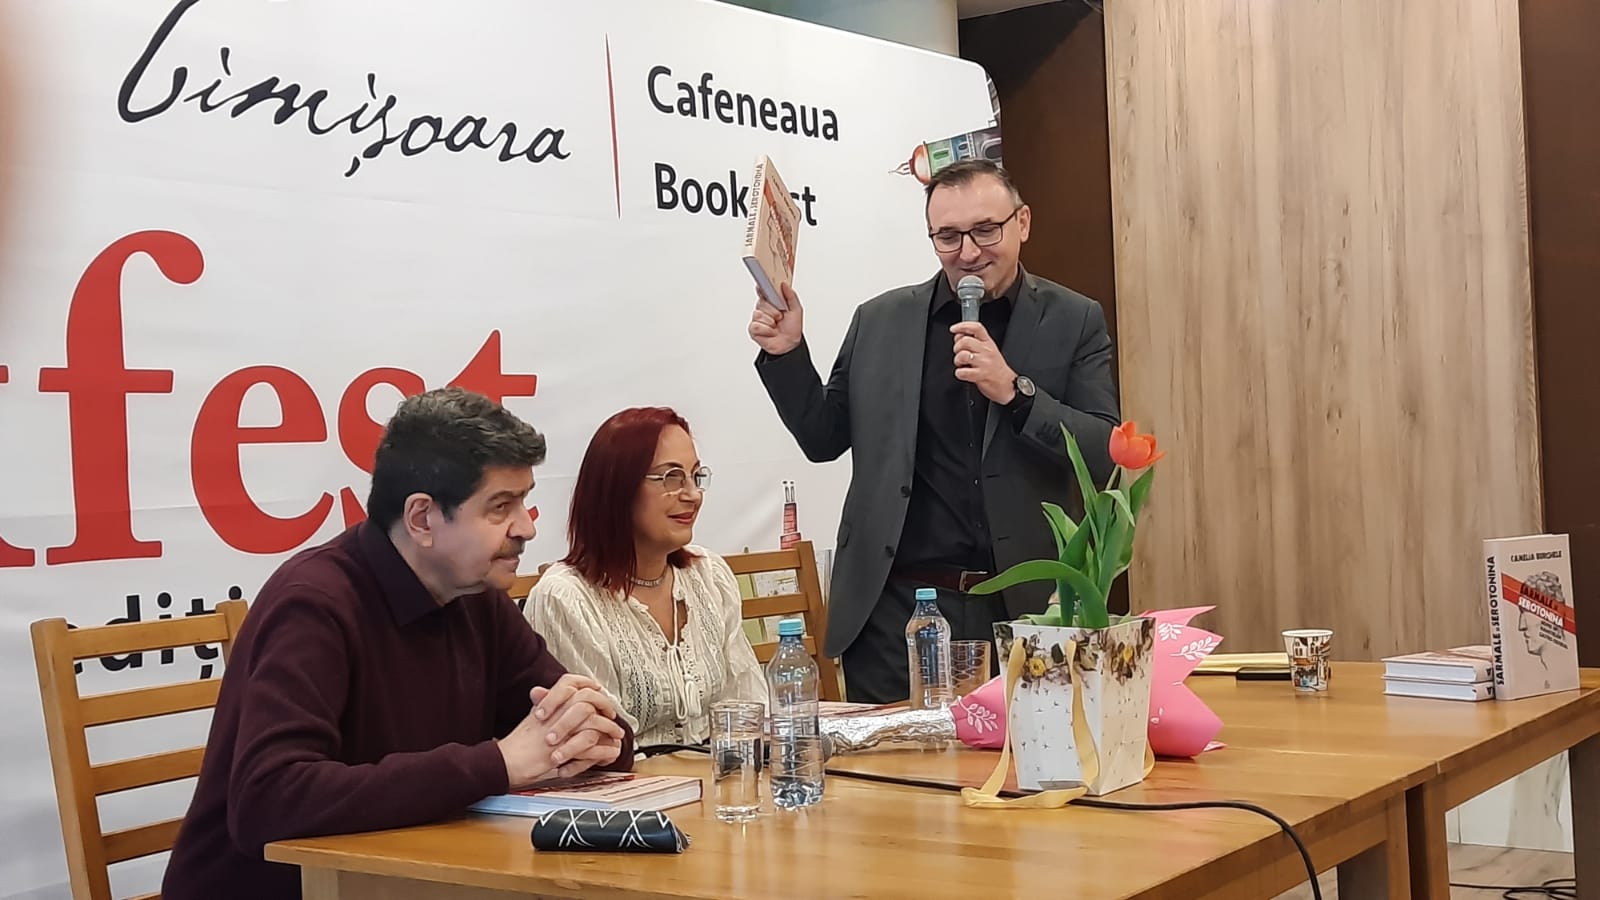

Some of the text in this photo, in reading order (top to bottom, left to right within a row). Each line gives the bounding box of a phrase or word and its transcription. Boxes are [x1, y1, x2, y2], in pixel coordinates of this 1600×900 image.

[647, 65, 839, 141] Cafeneaua
[654, 162, 818, 226] Bookt
[1486, 556, 1504, 686] SARMALE SEROTONINA
